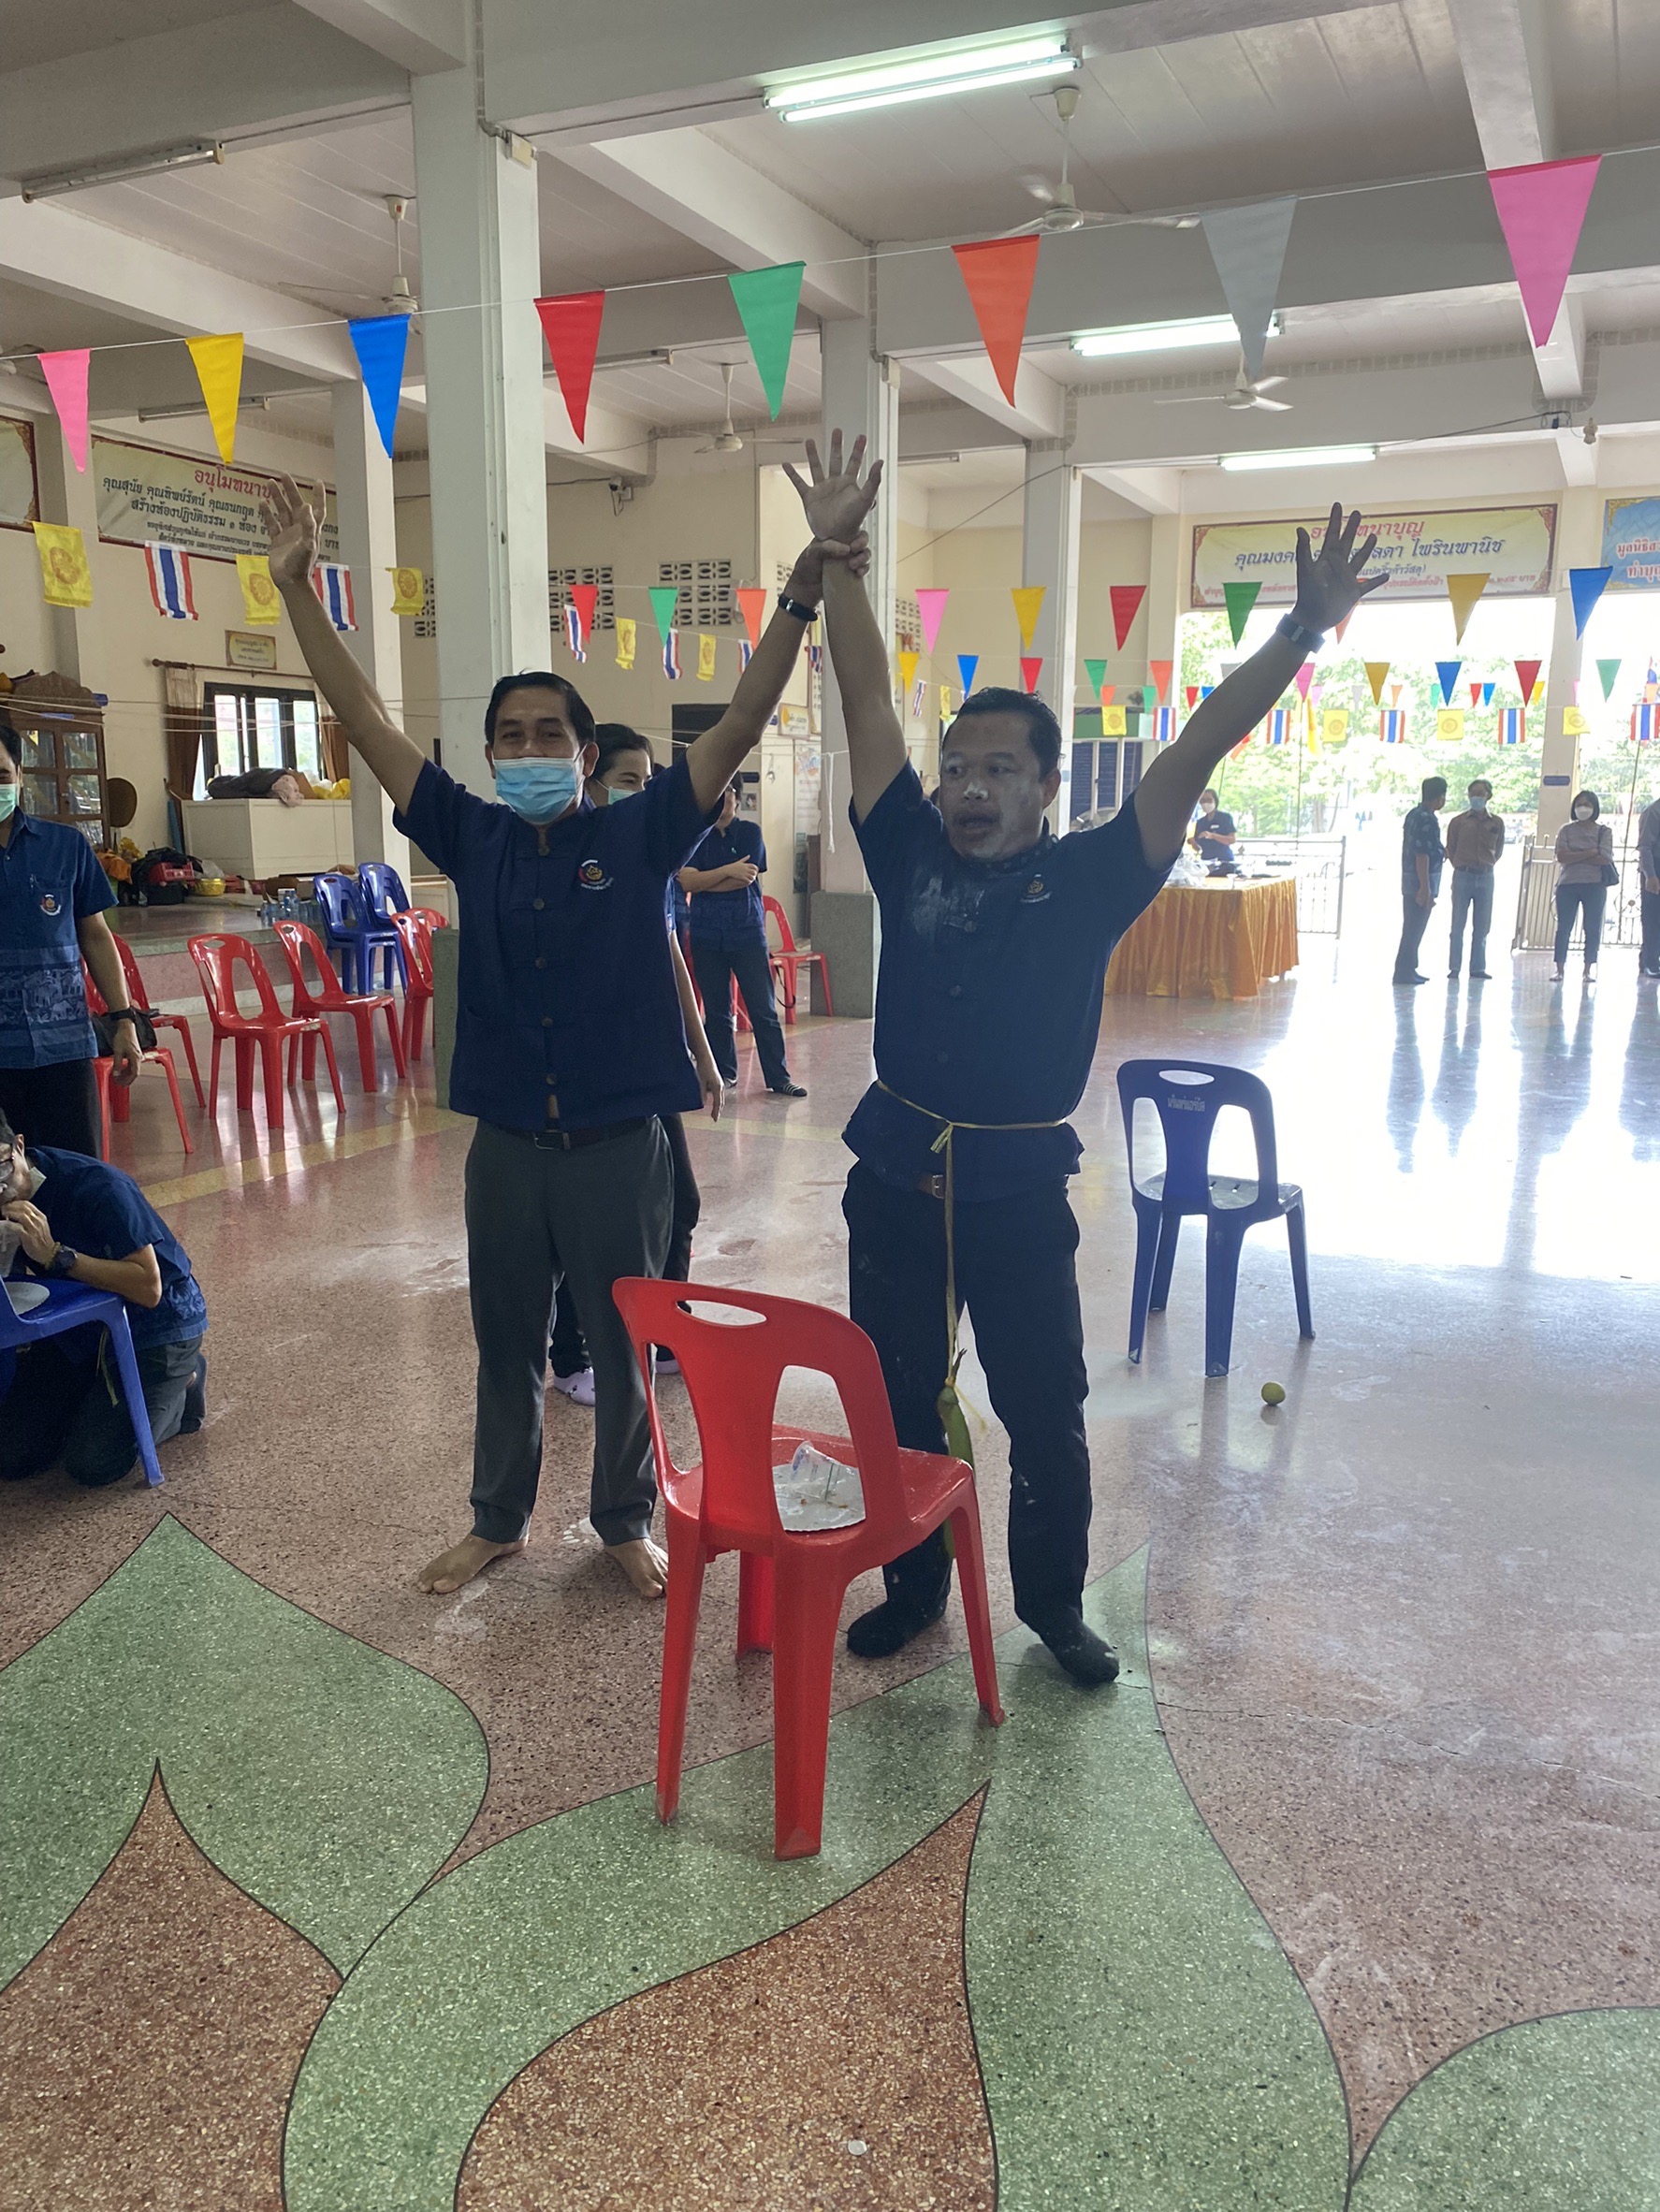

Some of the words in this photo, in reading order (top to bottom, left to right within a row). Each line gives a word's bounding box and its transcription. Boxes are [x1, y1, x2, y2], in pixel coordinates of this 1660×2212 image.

[103, 477, 142, 495] คุณสุนัย
[147, 486, 206, 506] คุณทิพย์รัตน์
[195, 466, 271, 502] อนุโมทนาบุ
[131, 497, 226, 526] สร้างห้องปฏิบัติธรรม
[1235, 551, 1294, 571] คุณมงค
[1412, 536, 1506, 557] ไพรินพานิช
[1617, 538, 1660, 559] มูลนิธิส
